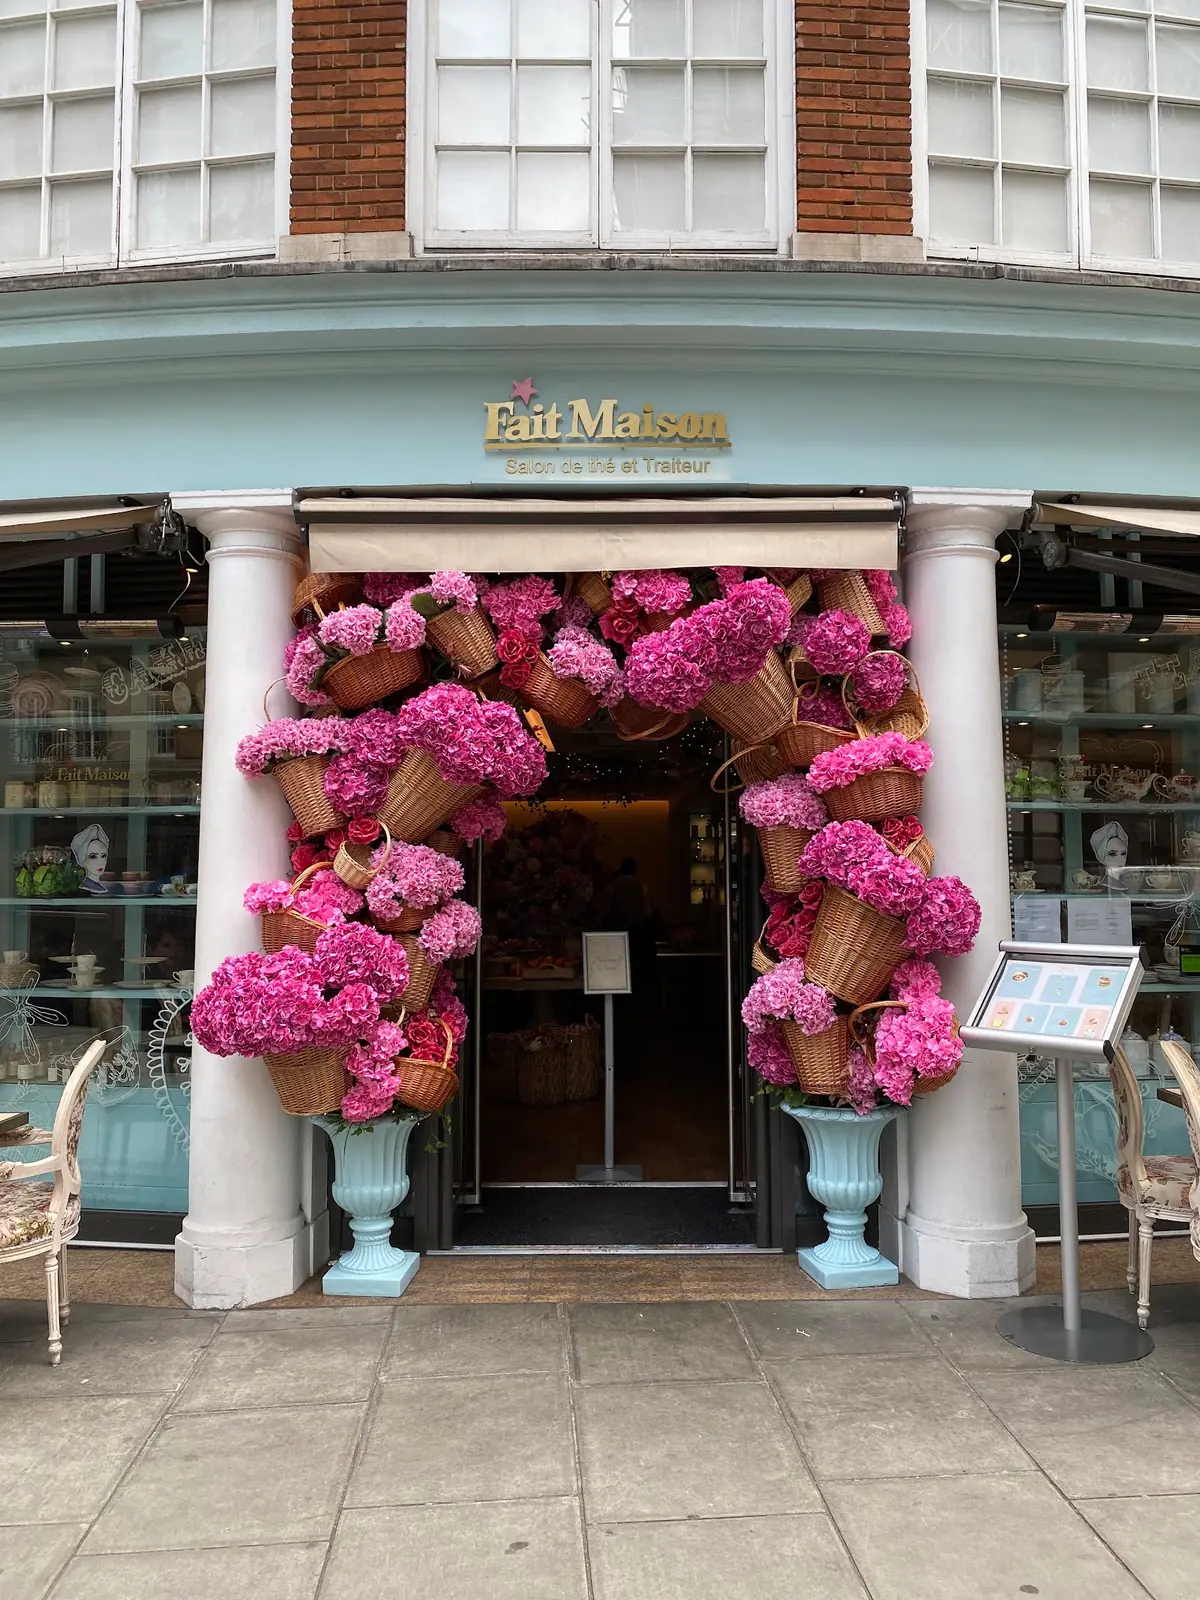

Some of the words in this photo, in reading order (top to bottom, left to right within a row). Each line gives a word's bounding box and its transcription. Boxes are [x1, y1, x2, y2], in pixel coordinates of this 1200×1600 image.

[484, 401, 562, 441] Fait
[565, 399, 728, 439] Maison
[505, 457, 555, 474] Salon
[561, 458, 583, 474] de
[588, 457, 615, 474] thé
[621, 458, 638, 473] et
[643, 456, 711, 473] Traiteur
[57, 767, 81, 781] Fait
